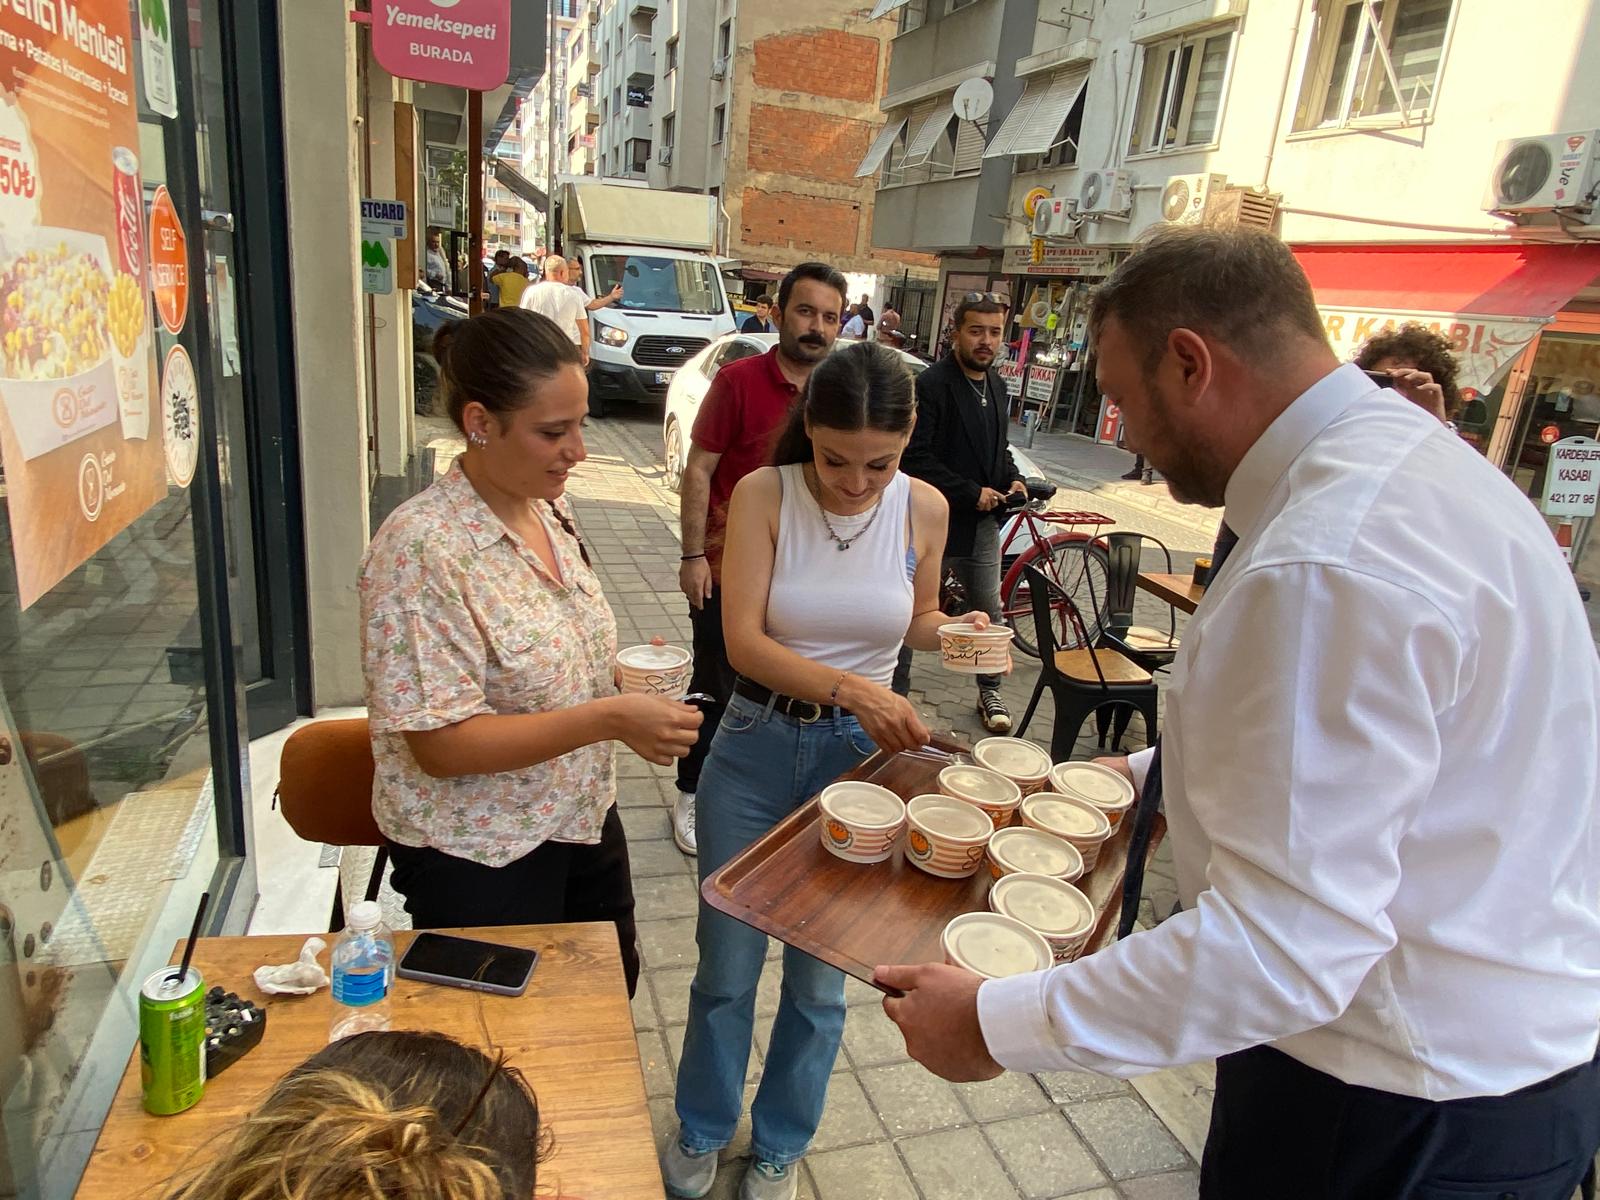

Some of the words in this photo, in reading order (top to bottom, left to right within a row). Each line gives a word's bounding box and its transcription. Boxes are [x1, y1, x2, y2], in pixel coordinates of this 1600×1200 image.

[386, 4, 496, 40] Yemeksepeti
[61, 0, 127, 75] Menüsü
[409, 42, 474, 65] BURADA
[161, 227, 176, 251] SELF
[1559, 469, 1592, 482] KASABI
[1549, 494, 1566, 503] 421
[1568, 494, 1580, 504] 27
[1583, 495, 1595, 504] 95
[942, 637, 992, 666] Soup
